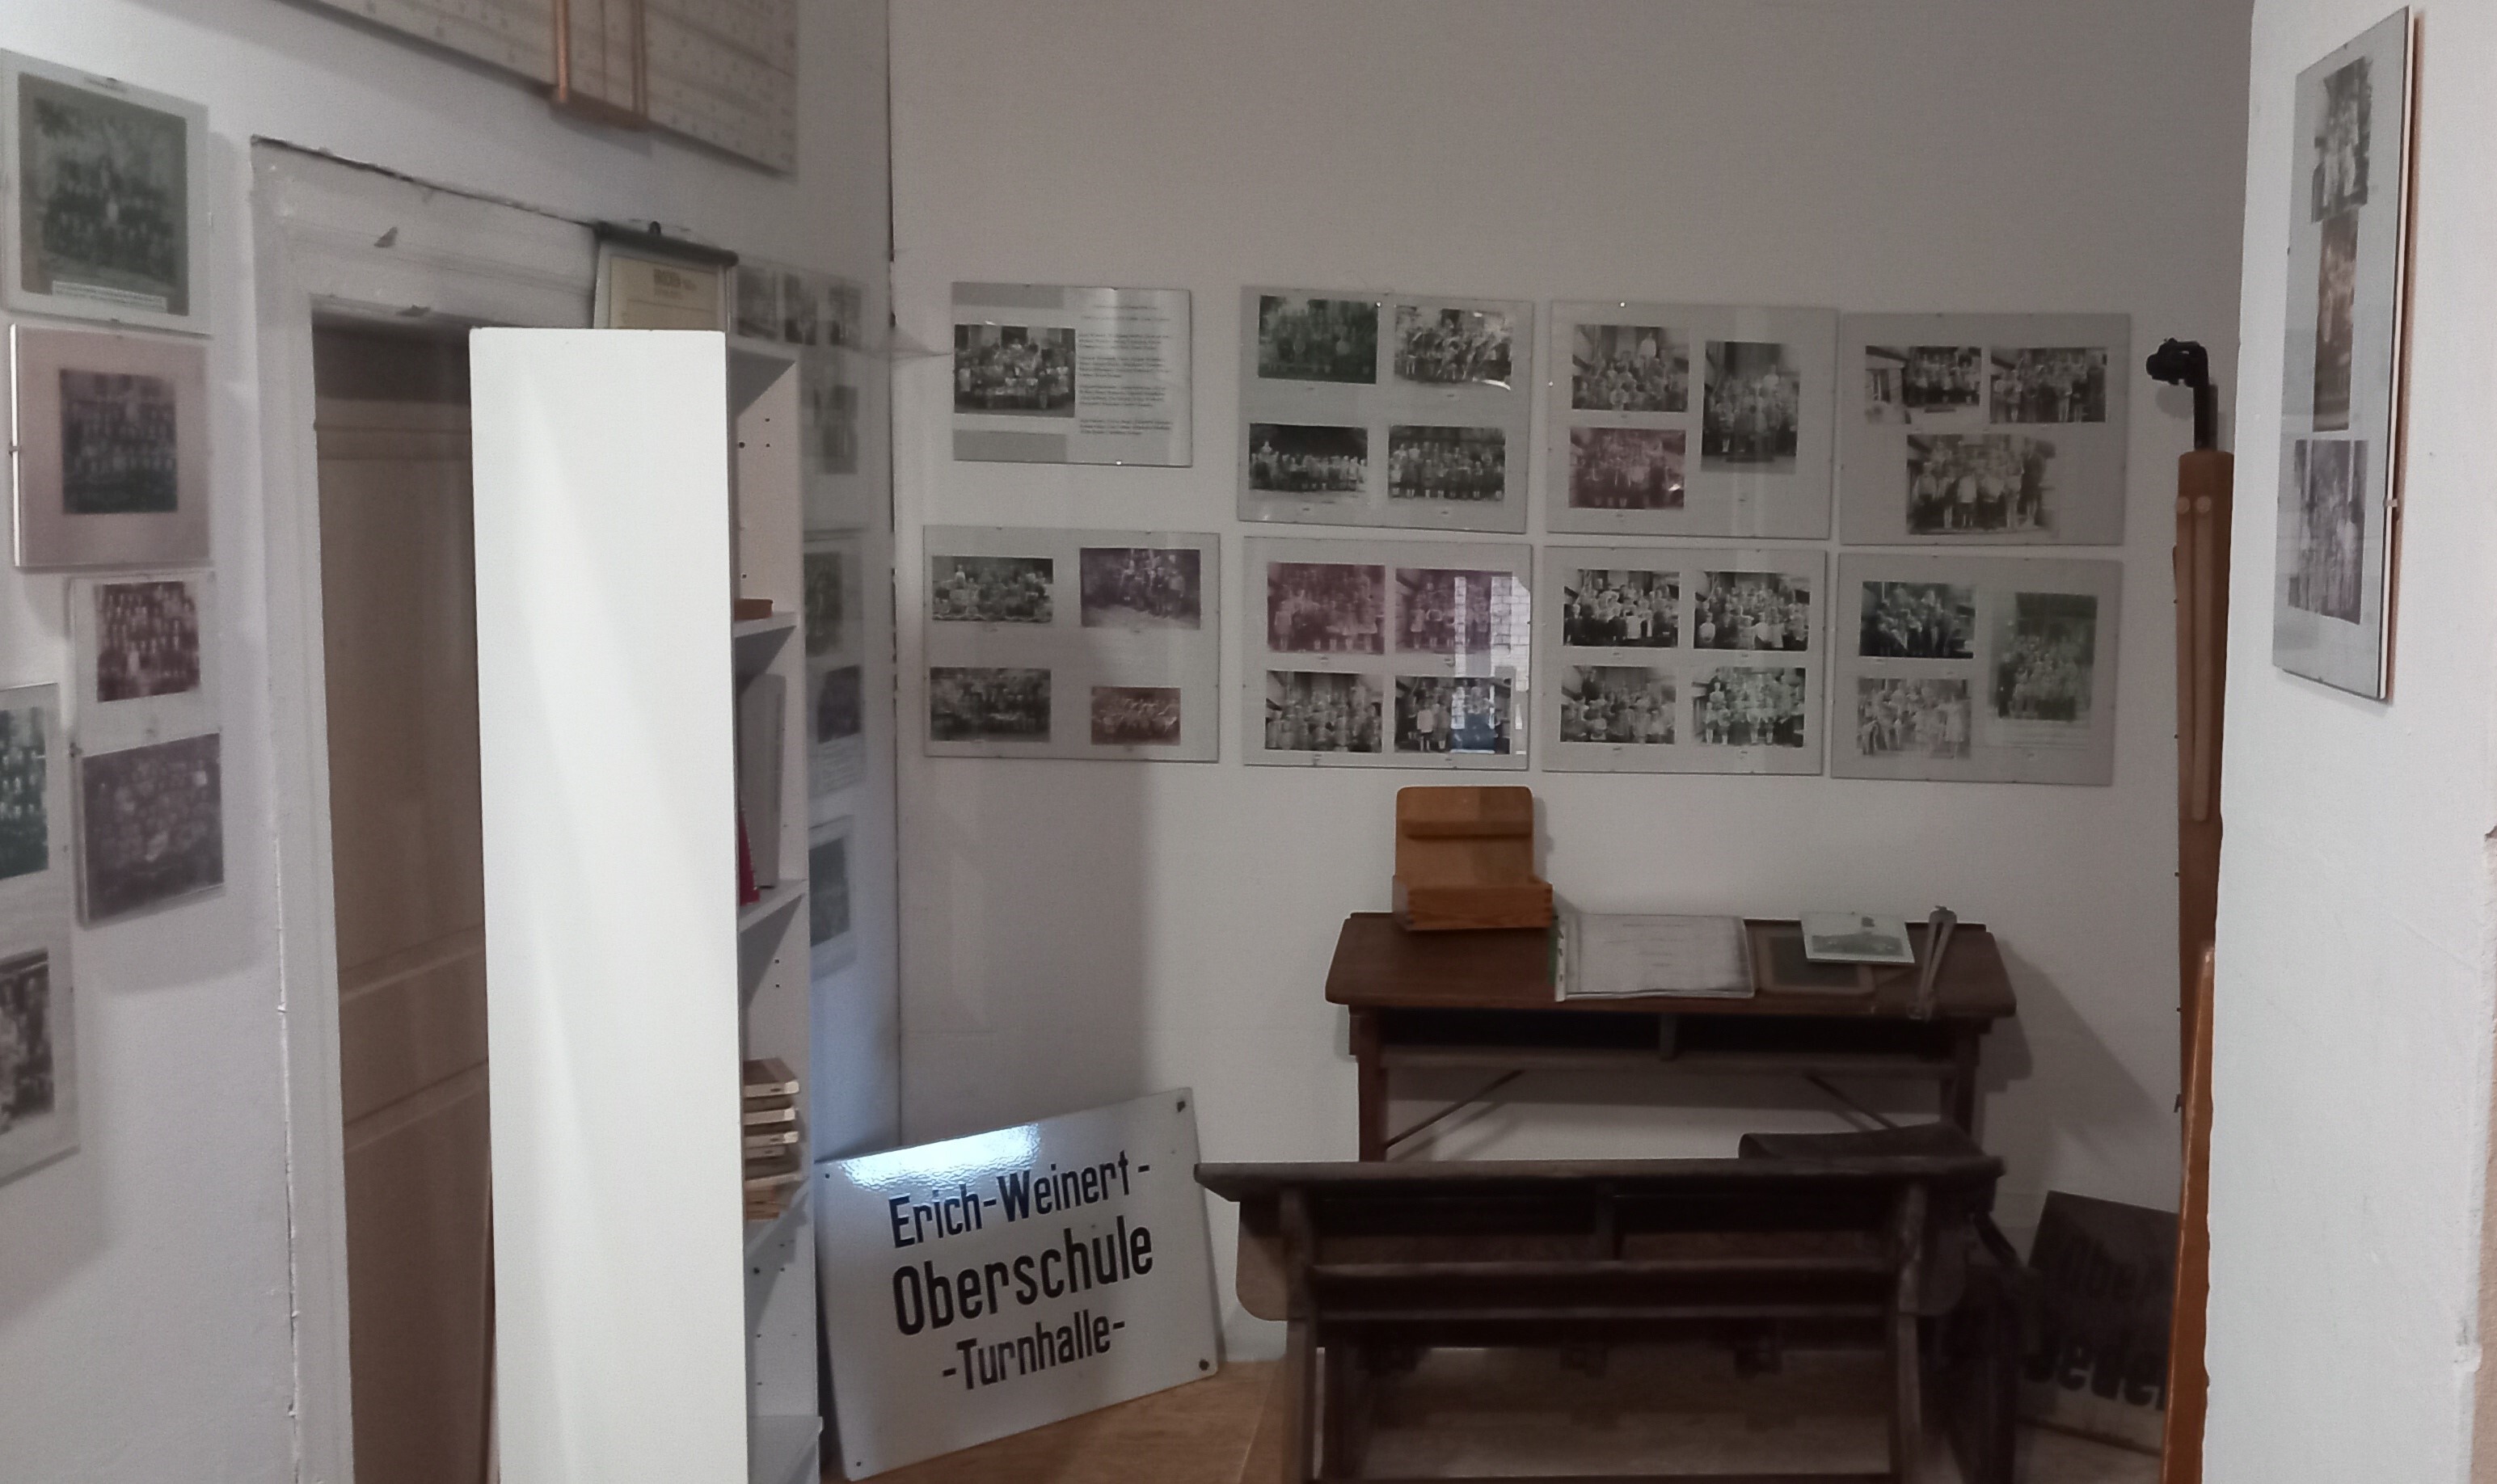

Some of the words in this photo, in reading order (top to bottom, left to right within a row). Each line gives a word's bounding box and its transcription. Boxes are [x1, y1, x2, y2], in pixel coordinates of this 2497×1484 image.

[888, 1149, 1151, 1249] Erich-Weinert-
[892, 1215, 1154, 1336] Oberschule
[942, 1309, 1127, 1391] -Turnhalle-
